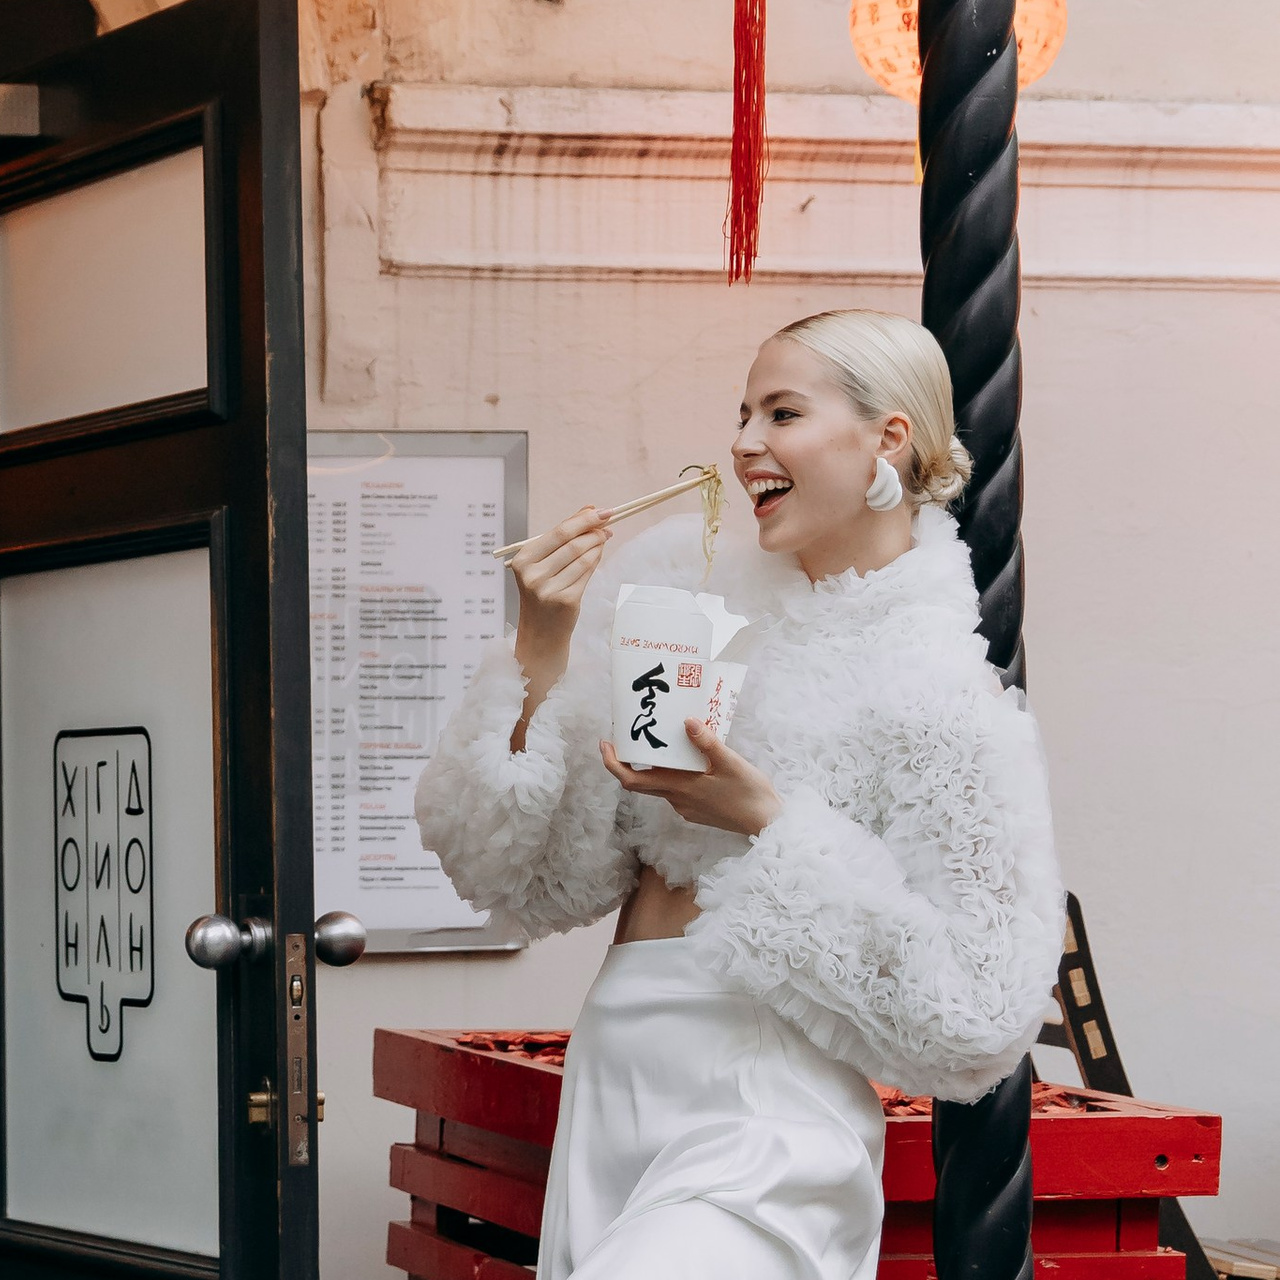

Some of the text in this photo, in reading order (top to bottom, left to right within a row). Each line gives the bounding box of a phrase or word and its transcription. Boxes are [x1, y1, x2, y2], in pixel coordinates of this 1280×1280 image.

[620, 636, 699, 654] MICROWAVE SAFE
[61, 761, 80, 968] ХОН
[95, 760, 111, 1034] ГИЛЬ
[125, 759, 145, 972] ДОН
